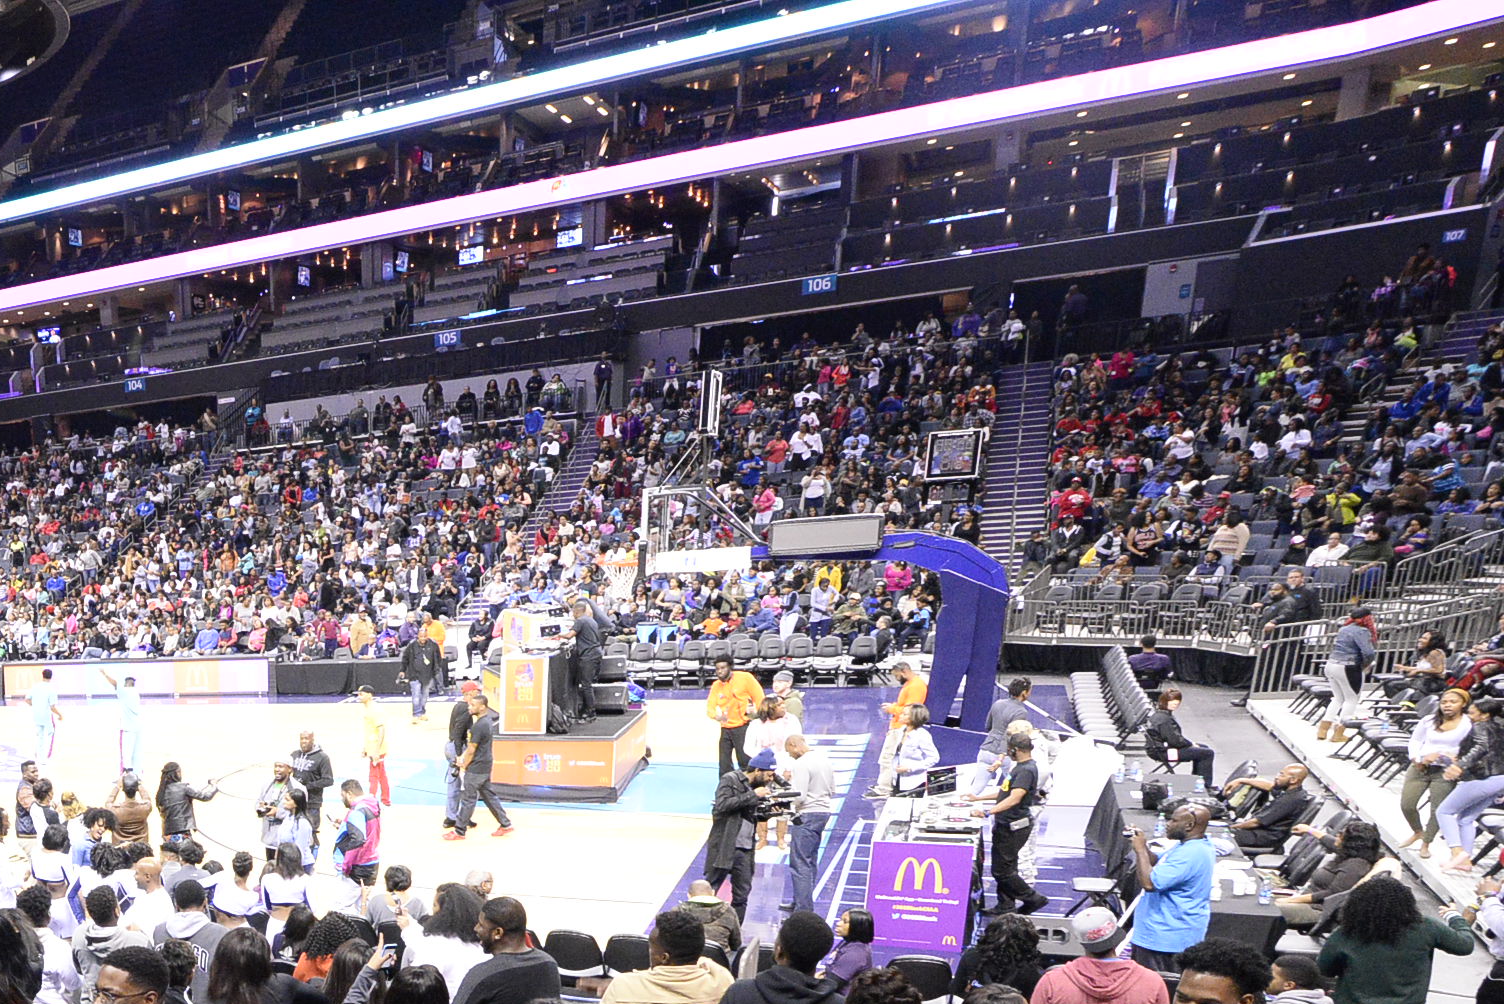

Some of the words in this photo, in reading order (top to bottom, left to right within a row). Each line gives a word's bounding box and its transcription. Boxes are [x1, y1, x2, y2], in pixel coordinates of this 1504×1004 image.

[1445, 229, 1466, 241] 107
[807, 277, 832, 292] 106
[438, 332, 457, 345] 105
[127, 380, 143, 391] 104
